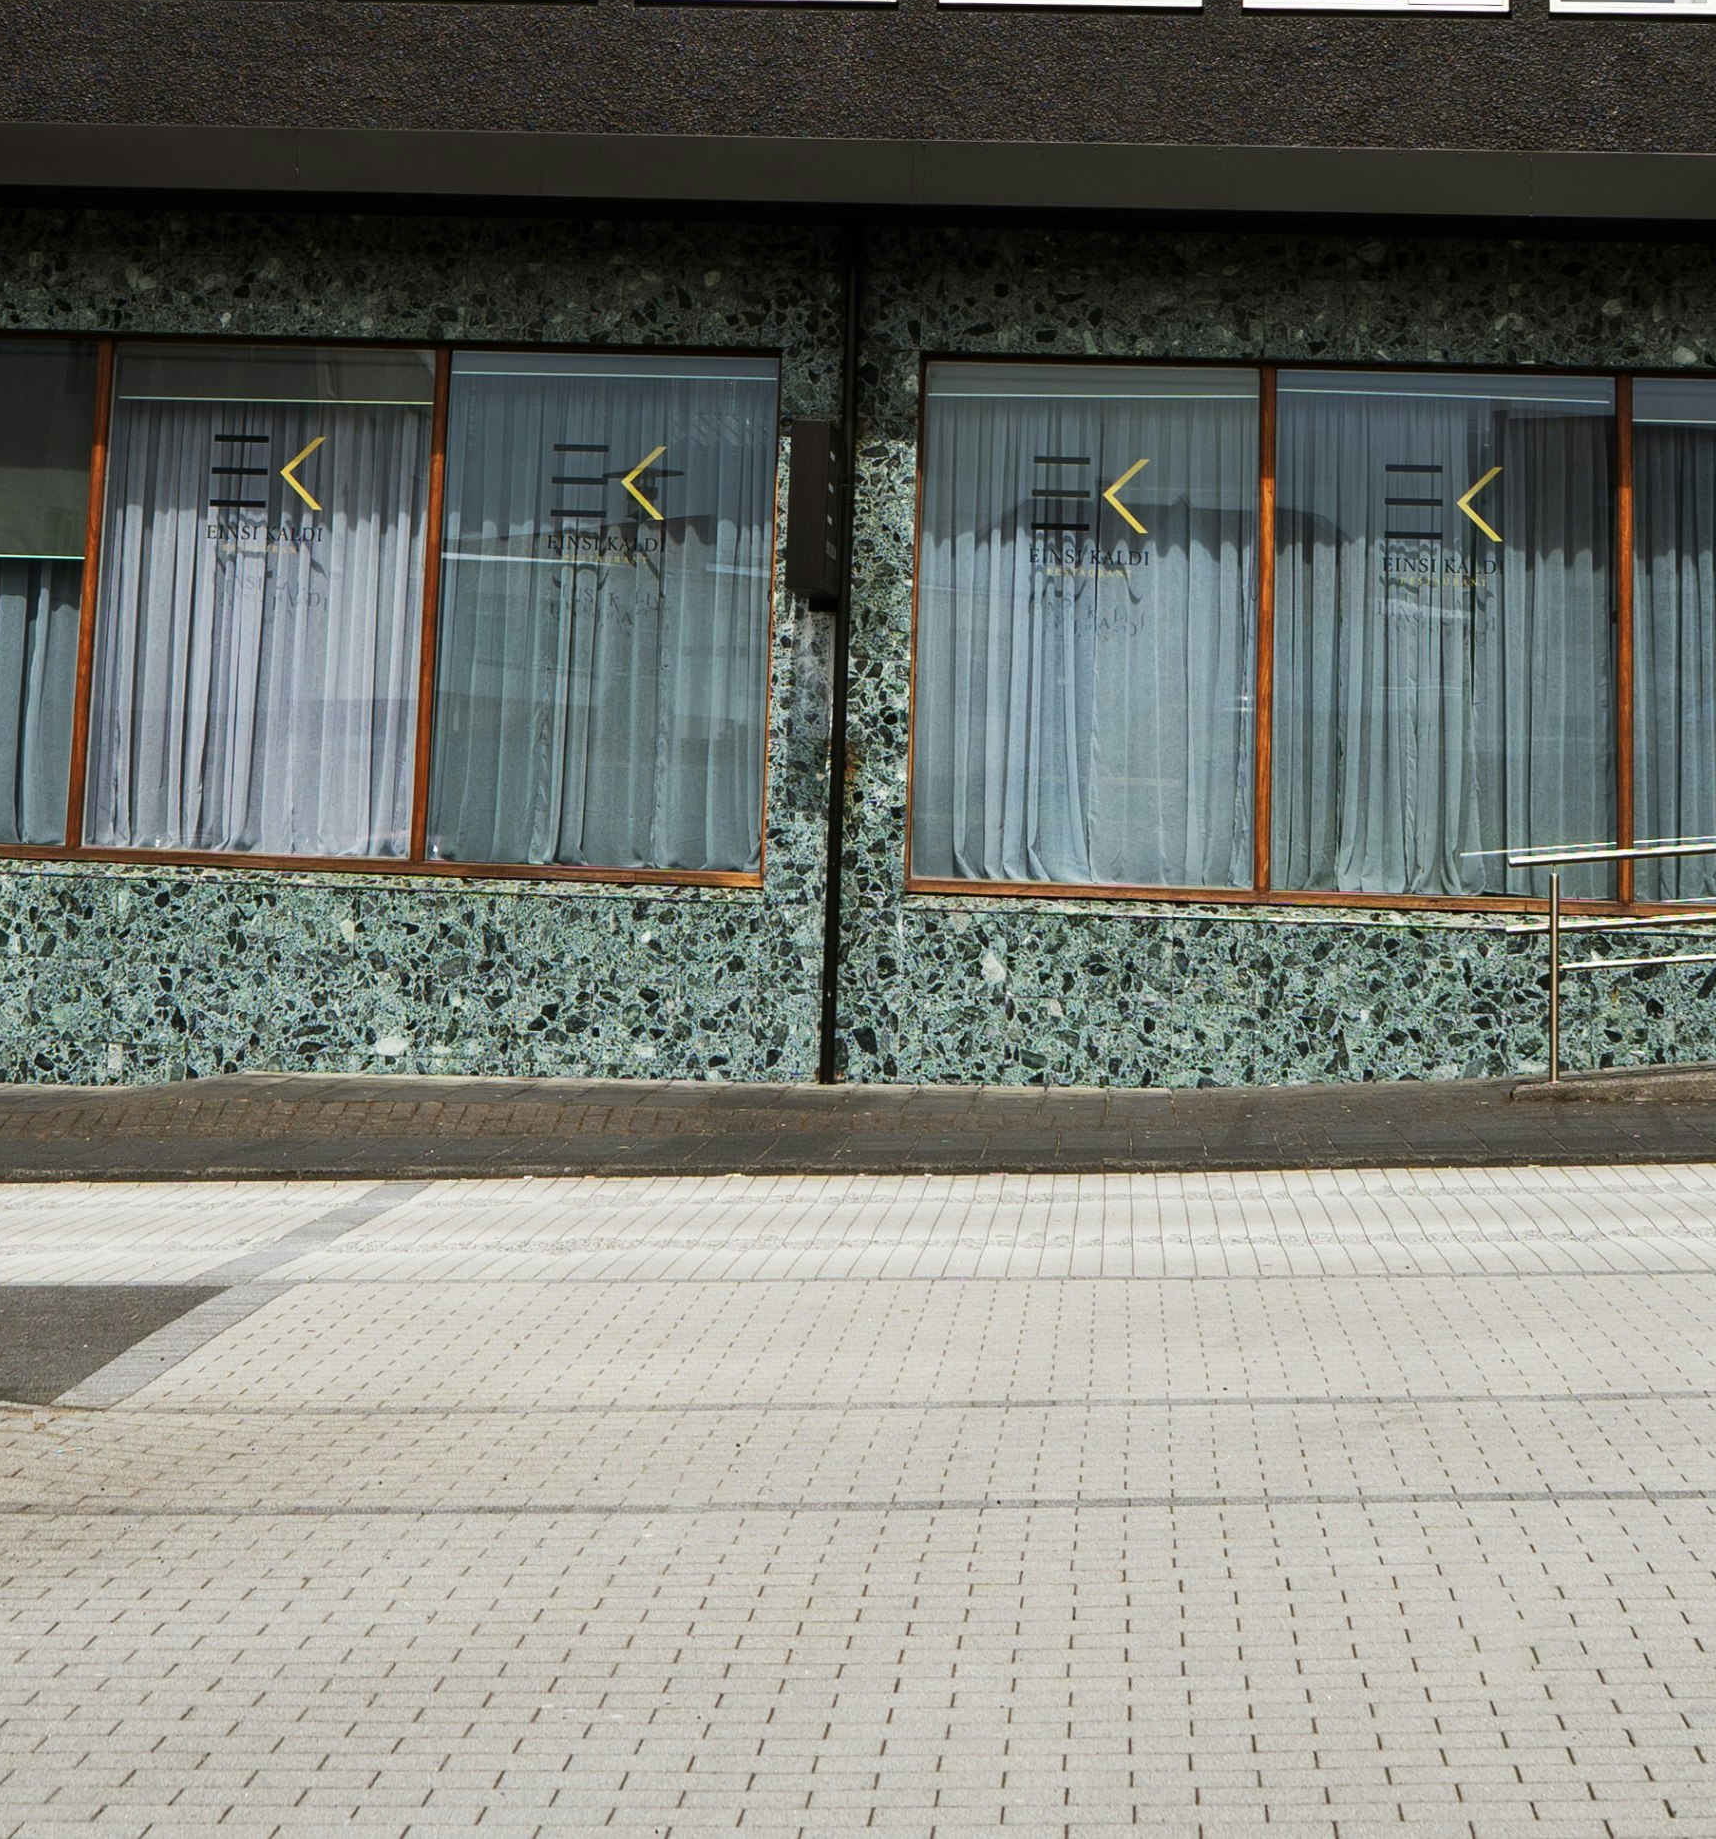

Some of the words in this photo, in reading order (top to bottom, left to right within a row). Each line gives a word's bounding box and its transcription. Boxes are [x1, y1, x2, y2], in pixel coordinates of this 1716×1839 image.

[206, 524, 260, 541] EINSI
[547, 535, 600, 551] EINSI
[1029, 547, 1082, 564] EINSI
[1090, 549, 1150, 566] KALDI
[1382, 557, 1437, 573] EINSI
